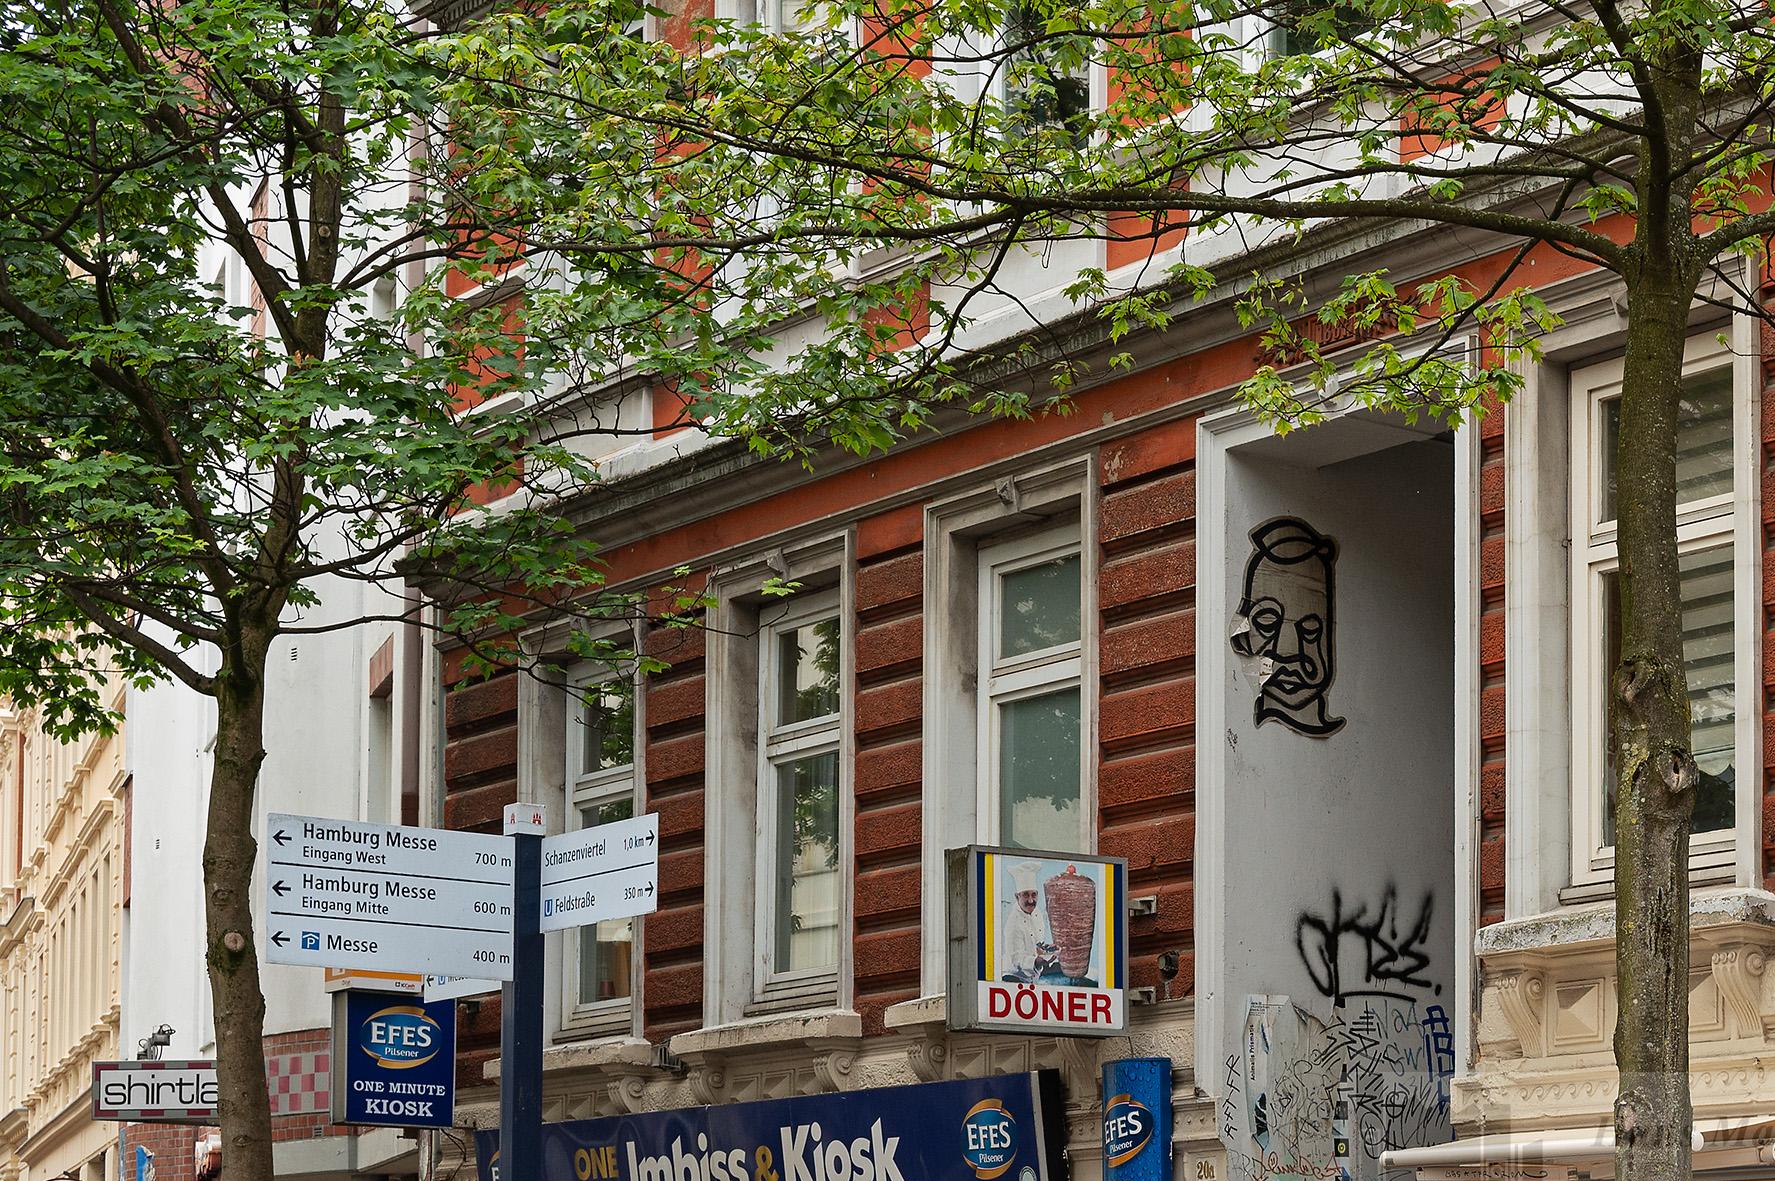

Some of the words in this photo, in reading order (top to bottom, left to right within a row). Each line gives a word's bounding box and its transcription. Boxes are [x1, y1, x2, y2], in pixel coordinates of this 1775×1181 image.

[303, 823, 380, 849] Hamburg
[386, 831, 437, 851] Messe
[302, 846, 353, 865] Eingang
[355, 852, 387, 866] West
[474, 852, 498, 867] 700
[500, 856, 512, 868] m
[545, 839, 606, 867] Schanzenviertel
[634, 836, 645, 848] km
[302, 873, 380, 899] Hamburg
[385, 881, 437, 901] Messe
[301, 896, 352, 915] Eingang
[355, 900, 390, 916] Mitte
[473, 901, 497, 915] 600
[500, 905, 512, 917] m
[555, 891, 596, 914] Feldstraße
[624, 887, 636, 900] 350
[327, 934, 378, 953] Messe
[472, 950, 497, 964] 400
[499, 953, 511, 965] m
[988, 983, 1113, 1024] DÖNER
[370, 1022, 432, 1047] EFES
[384, 1047, 419, 1058] Pilsener
[353, 1080, 385, 1093] ONE
[388, 1081, 446, 1096] MINUTE
[365, 1099, 434, 1118] KIOSK
[966, 1120, 1012, 1150] EFES
[1104, 1111, 1142, 1144] EFES
[979, 1152, 1004, 1164] Pilsener
[1109, 1140, 1133, 1154] Pilsener
[574, 1146, 619, 1181] ONE
[1196, 1160, 1215, 1179] 20a
